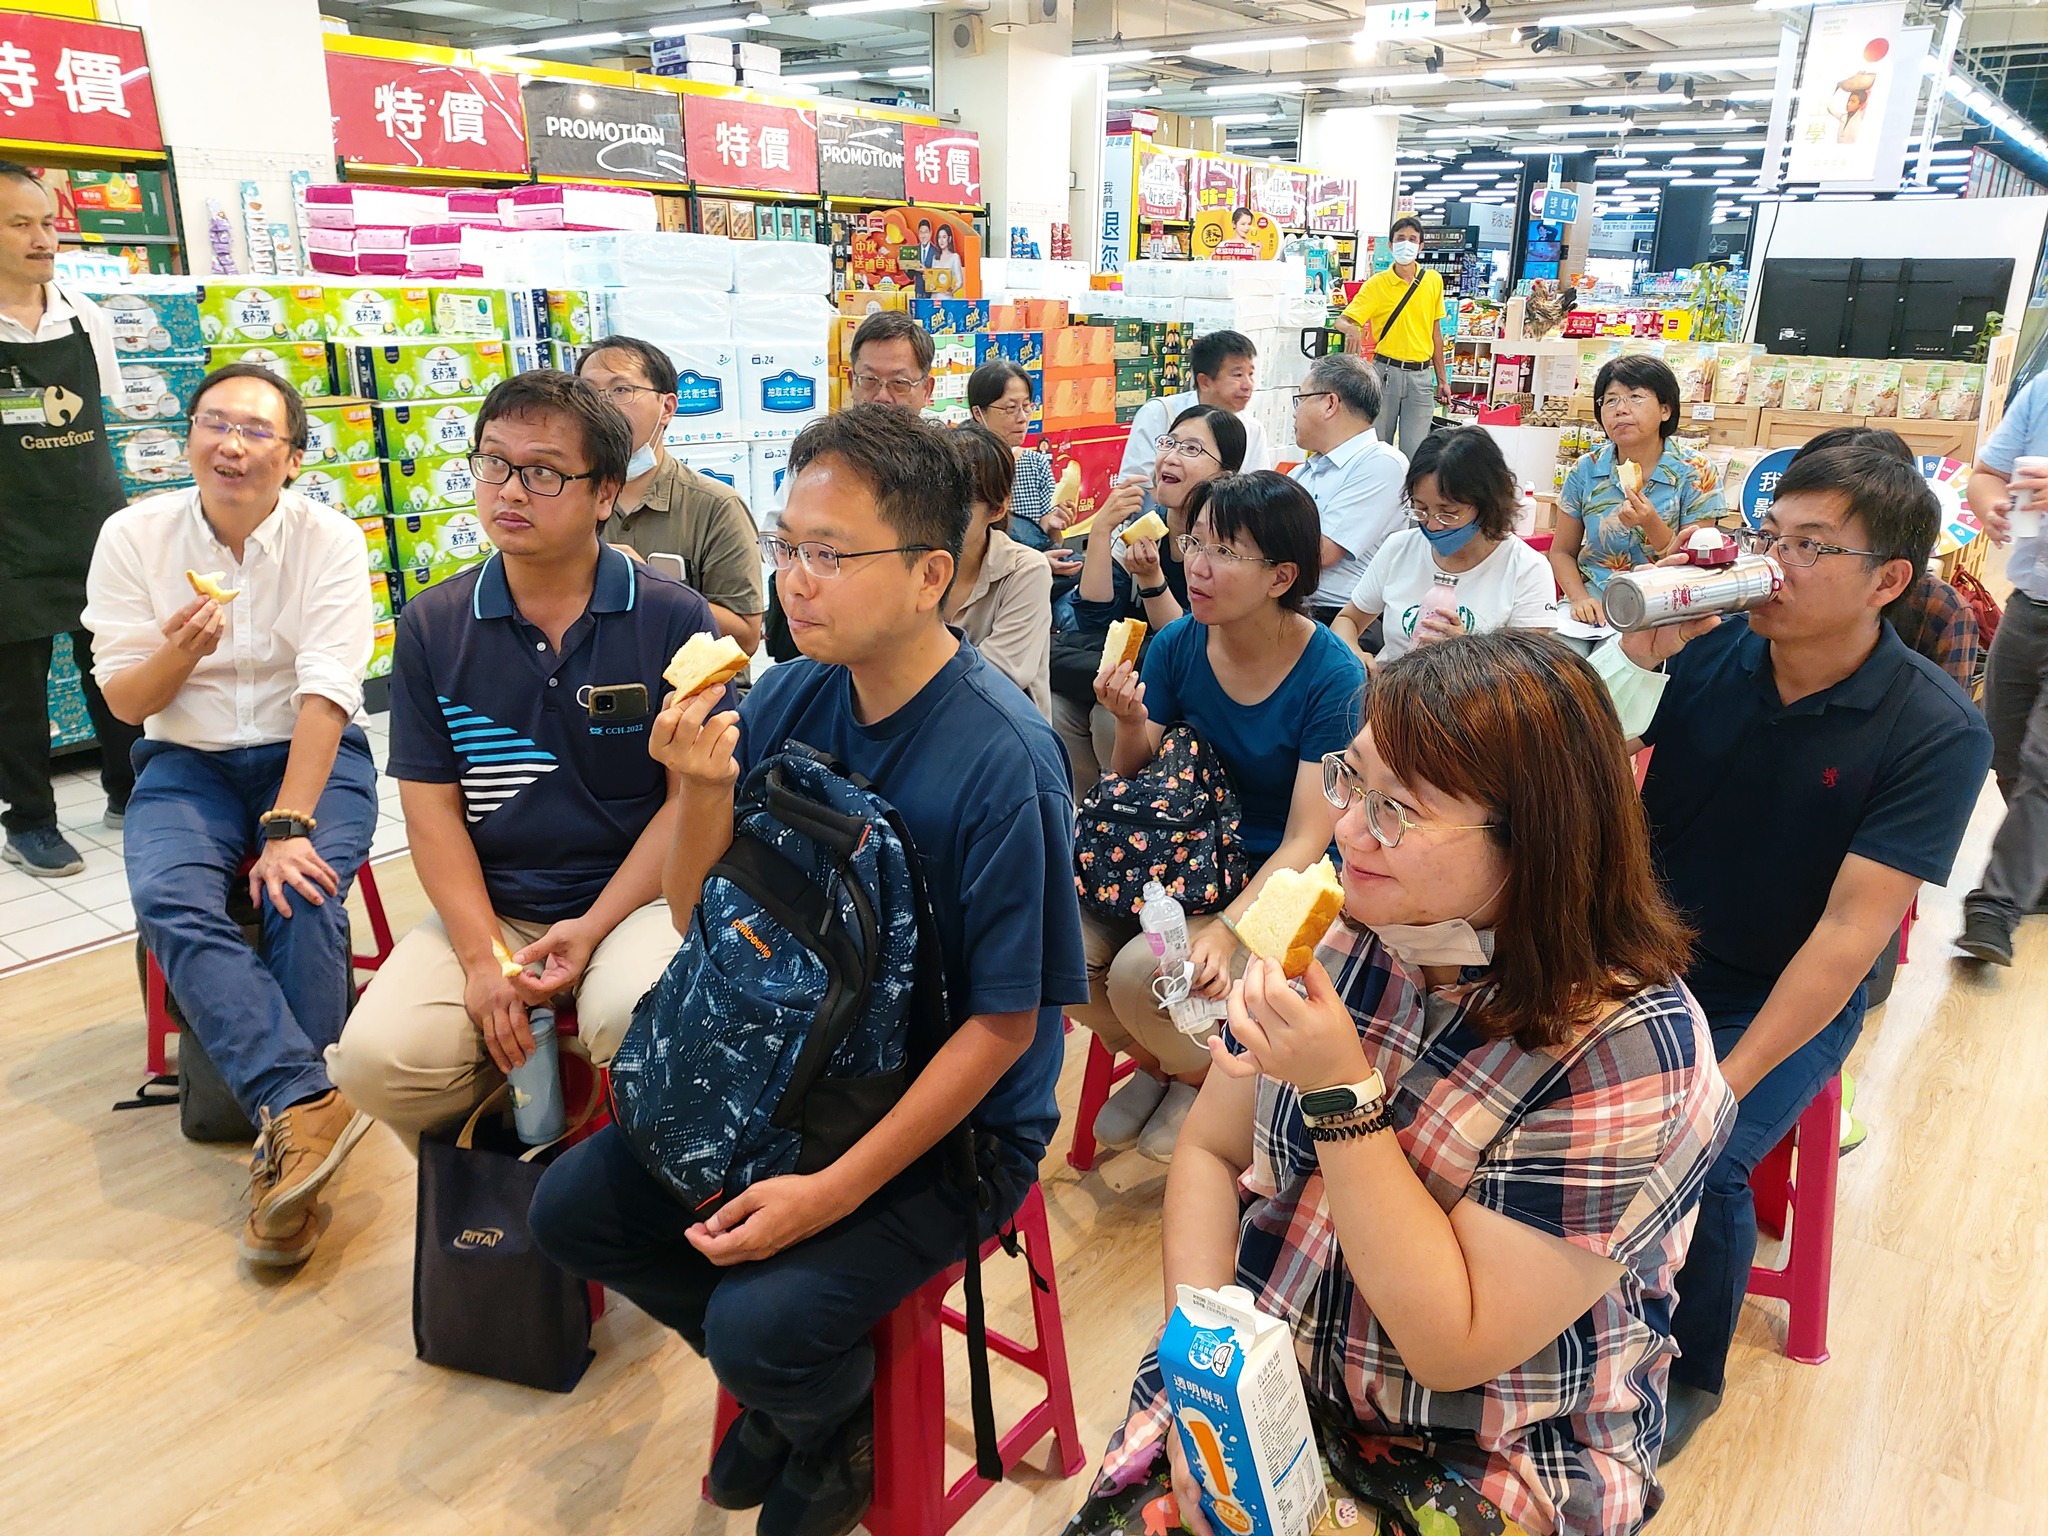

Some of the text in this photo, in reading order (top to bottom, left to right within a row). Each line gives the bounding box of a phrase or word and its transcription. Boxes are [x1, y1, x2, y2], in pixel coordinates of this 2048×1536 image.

[0, 41, 131, 118] 特價
[374, 84, 488, 146] 特價
[546, 116, 666, 147] PROMOTION
[714, 122, 791, 171] 特價
[822, 144, 902, 169] PROMOTION
[914, 144, 971, 186] 特價
[854, 254, 897, 273] 送禮首選
[855, 240, 878, 254] 中秋
[20, 429, 96, 450] Carrefour
[1173, 1374, 1229, 1411] 透明鮮乳
